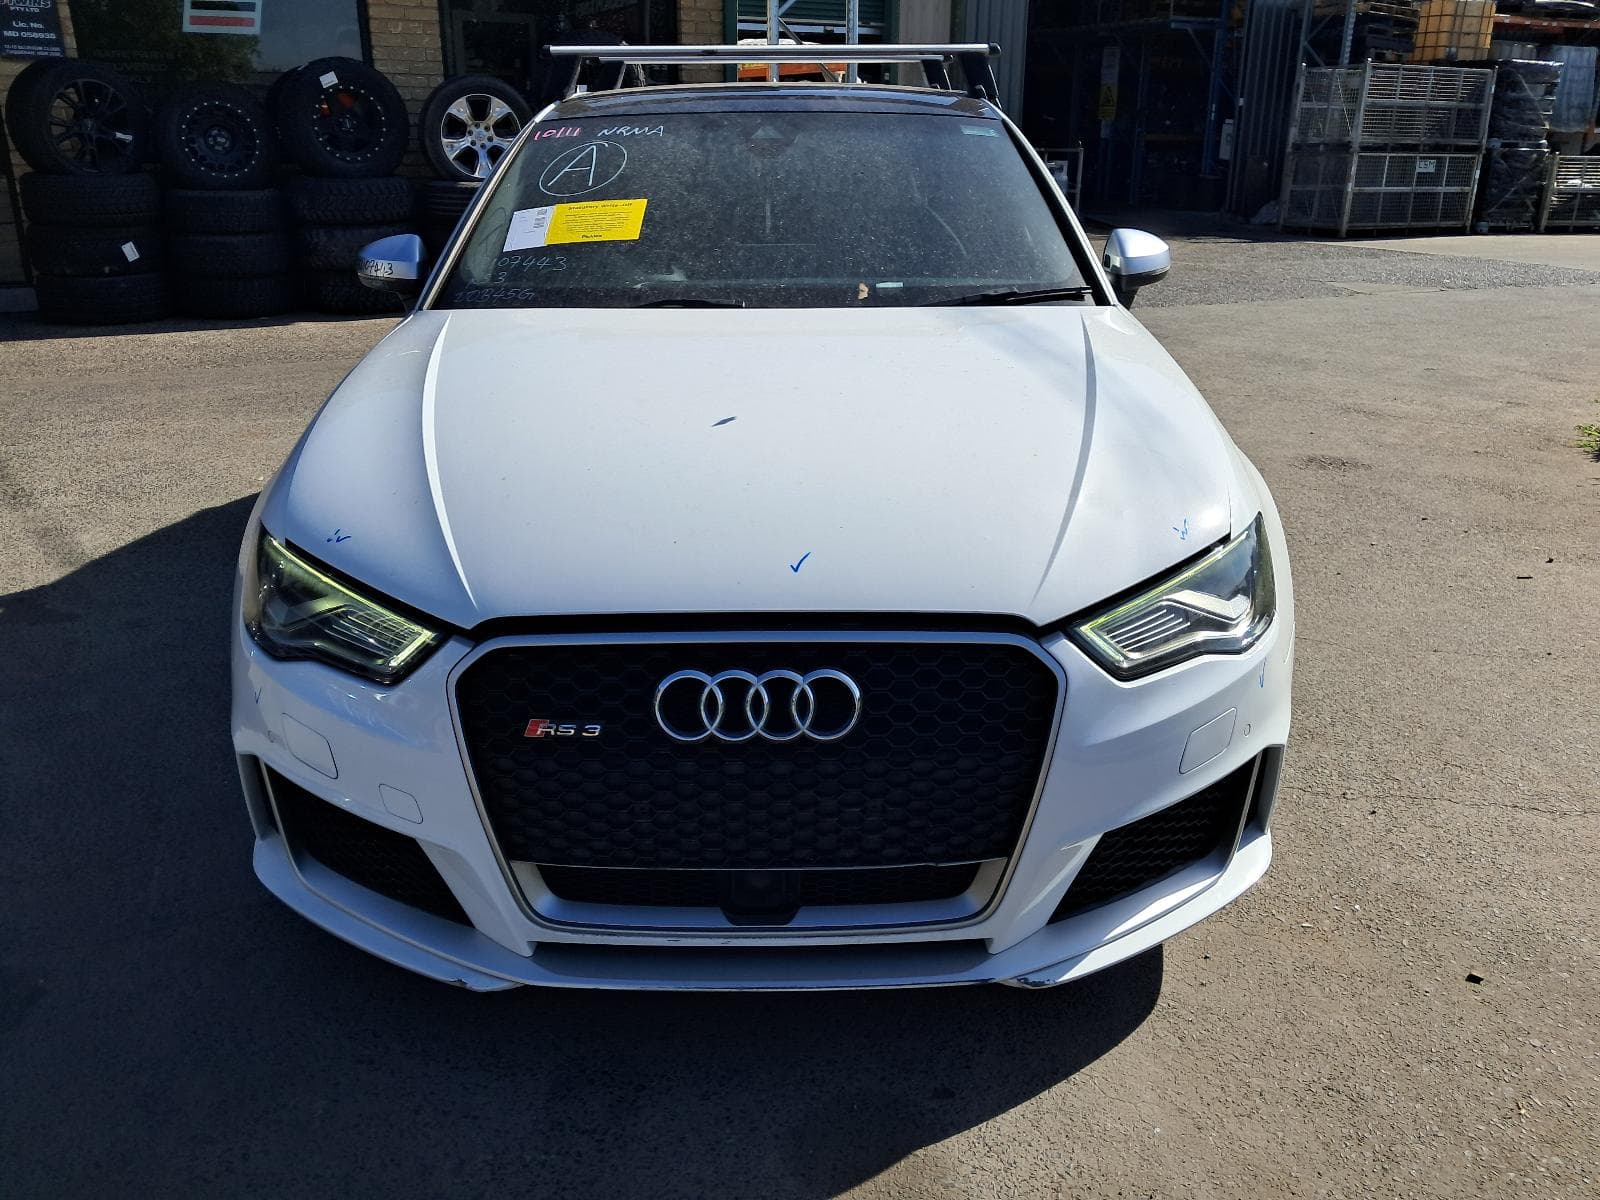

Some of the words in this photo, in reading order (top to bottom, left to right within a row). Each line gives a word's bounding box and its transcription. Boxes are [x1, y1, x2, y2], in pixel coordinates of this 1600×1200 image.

[597, 125, 664, 137] NRMA
[547, 144, 597, 187] A
[535, 722, 577, 736] RS
[582, 724, 601, 737] 3
